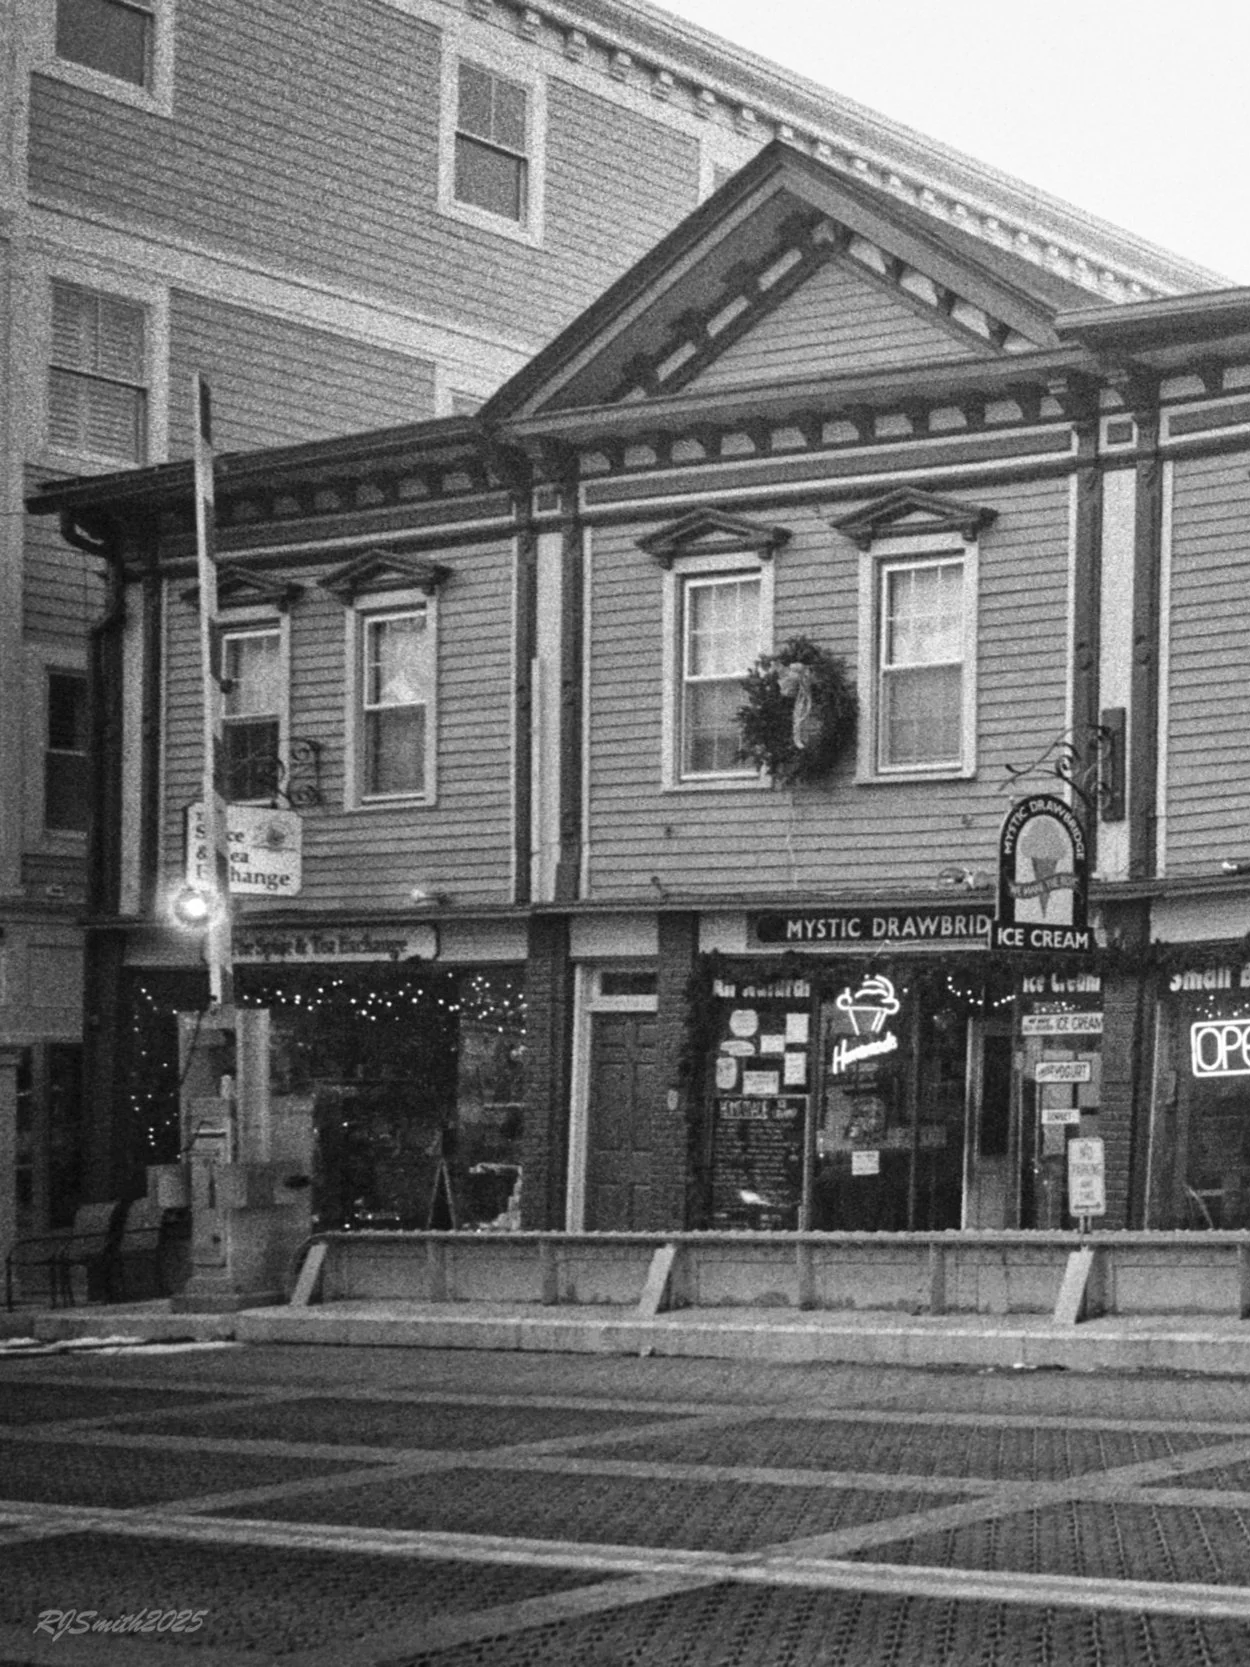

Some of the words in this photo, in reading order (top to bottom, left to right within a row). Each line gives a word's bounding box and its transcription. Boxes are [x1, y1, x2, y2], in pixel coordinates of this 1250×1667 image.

[195, 822, 246, 847] Sce
[1004, 806, 1029, 854] MYSTIC
[1029, 800, 1085, 860] DRAWBRIDGE
[196, 863, 292, 892] Ehange
[786, 917, 861, 939] MYSTIC
[872, 915, 991, 938] DRAWBRID
[997, 927, 1025, 947] ICE
[1030, 929, 1089, 949] CREAM
